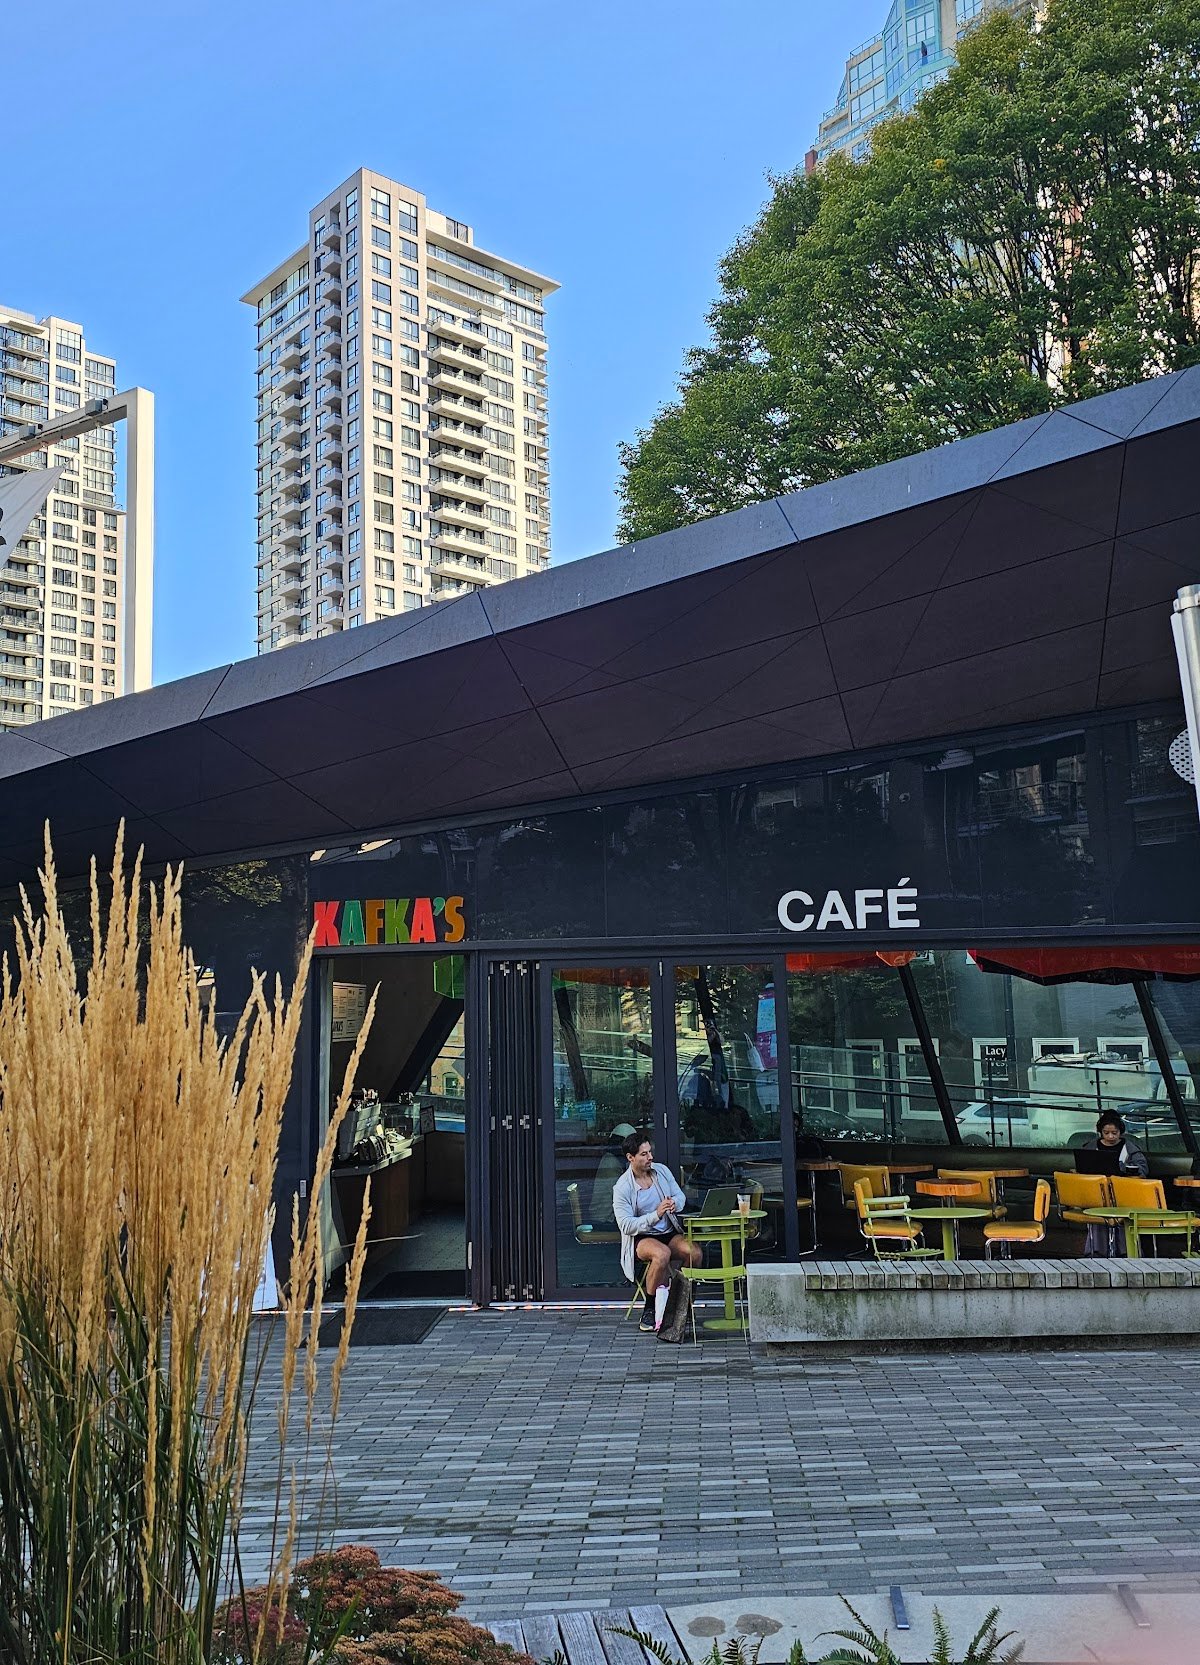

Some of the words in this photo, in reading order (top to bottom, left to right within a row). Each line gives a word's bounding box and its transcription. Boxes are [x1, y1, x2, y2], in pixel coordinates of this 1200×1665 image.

[313, 896, 466, 947] KAFKA'S
[777, 877, 920, 932] CAFÉ
[985, 1045, 1006, 1058] Lacy
